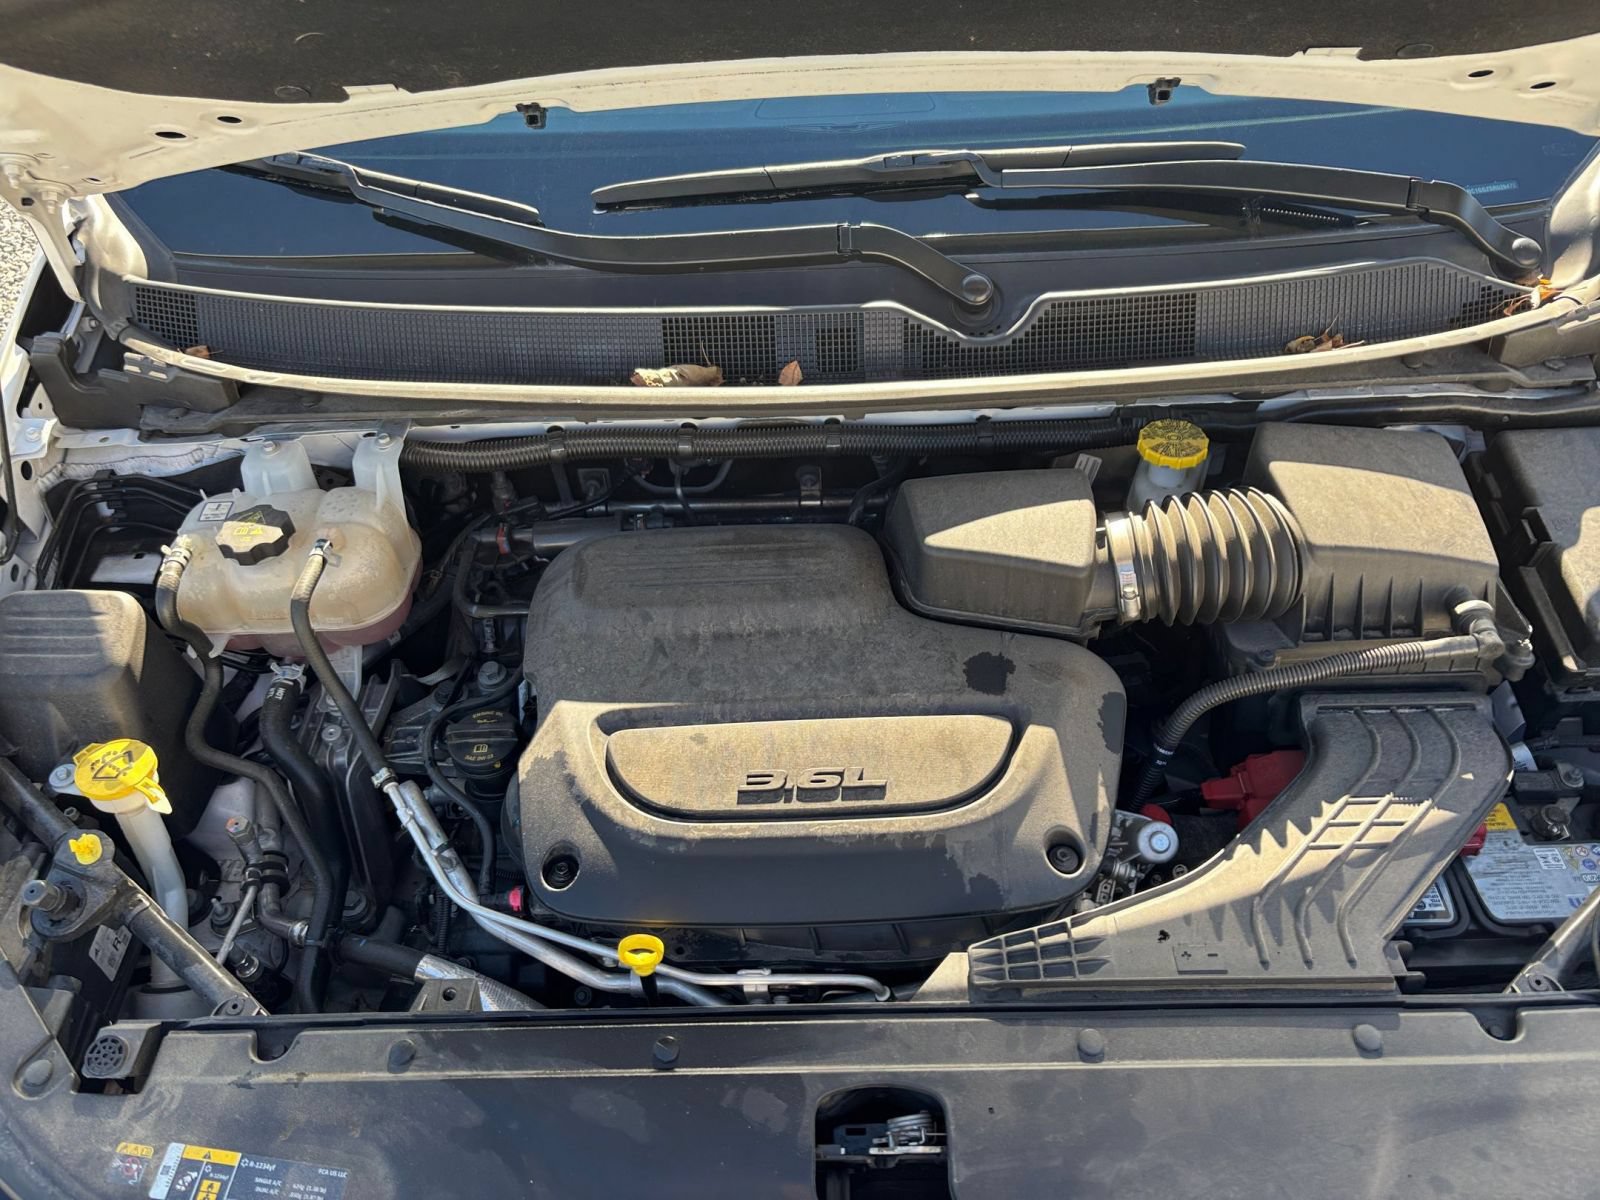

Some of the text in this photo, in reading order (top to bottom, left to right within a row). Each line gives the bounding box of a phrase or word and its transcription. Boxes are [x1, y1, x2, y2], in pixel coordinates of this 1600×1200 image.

[736, 767, 888, 803] 3.6L
[249, 1161, 277, 1172] R-1234yf
[318, 1168, 329, 1176] FCA
[272, 1179, 282, 1187] A/C
